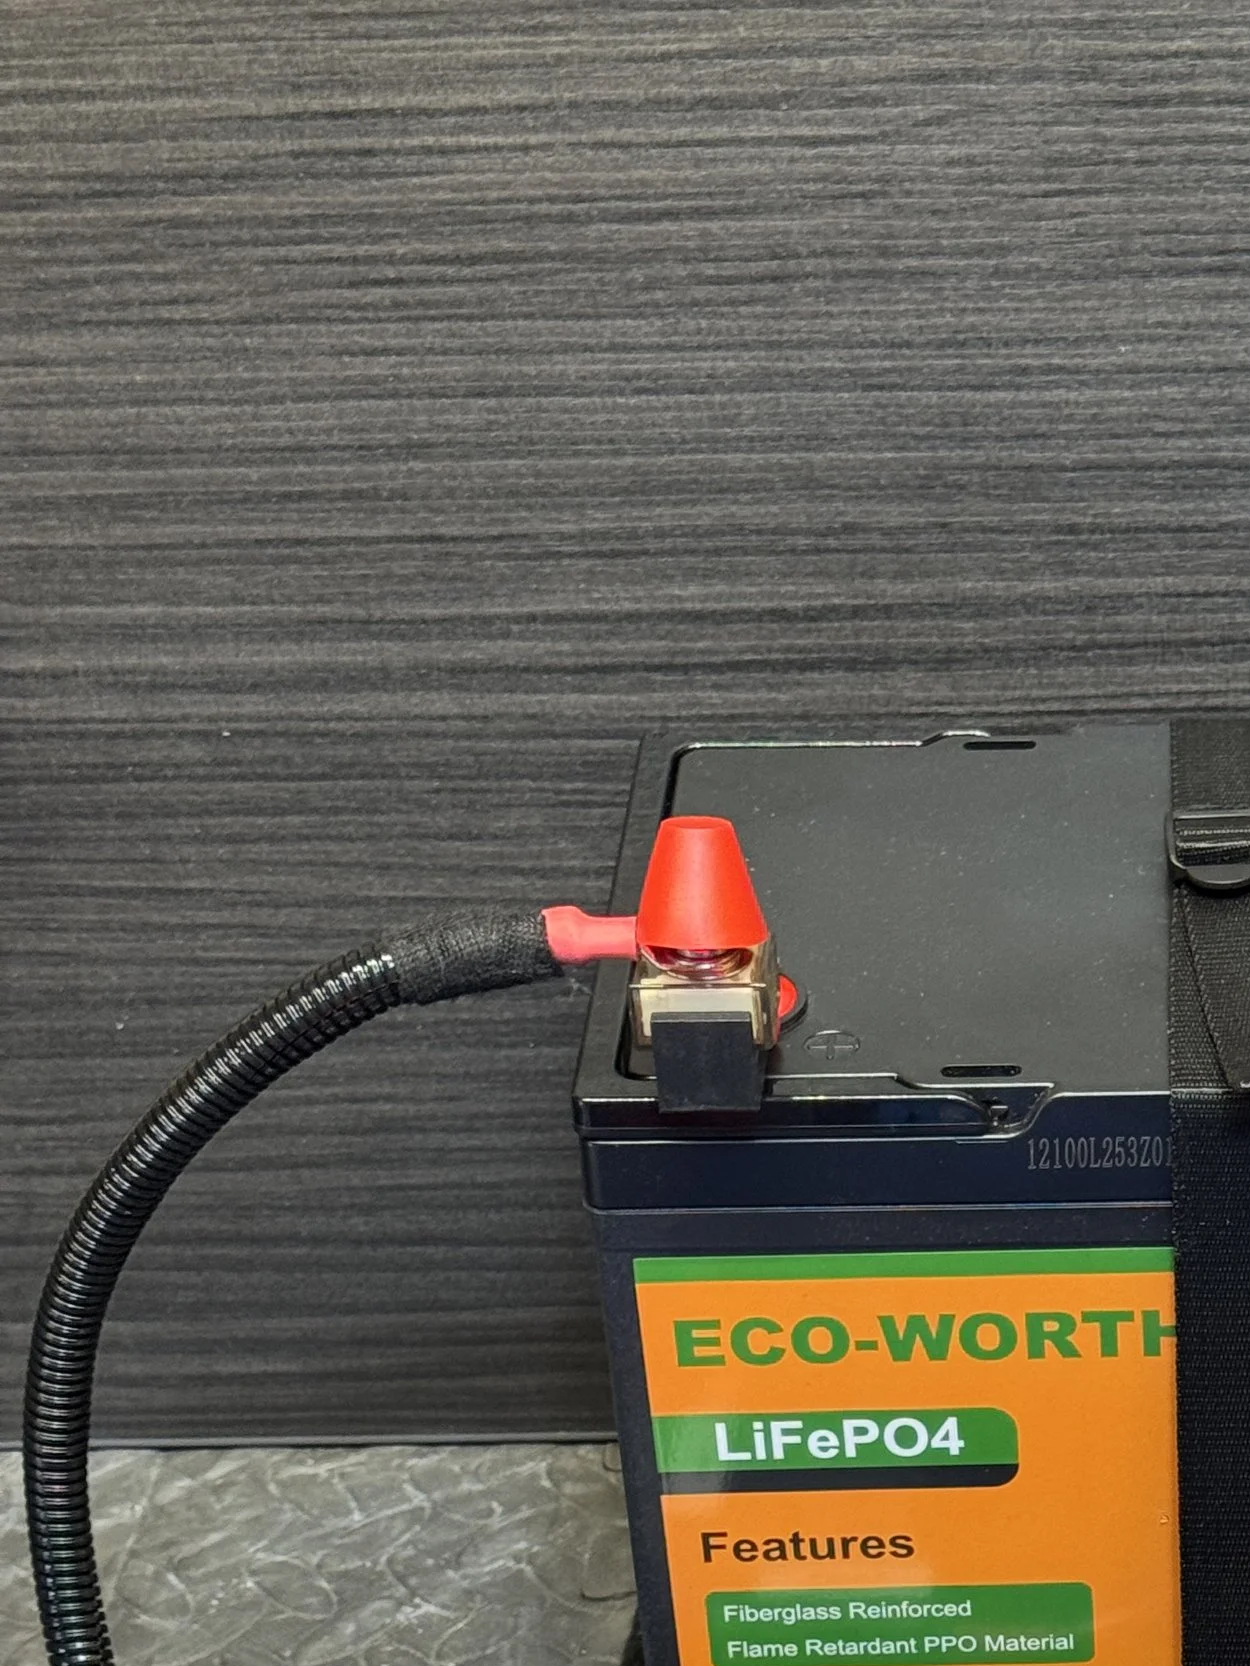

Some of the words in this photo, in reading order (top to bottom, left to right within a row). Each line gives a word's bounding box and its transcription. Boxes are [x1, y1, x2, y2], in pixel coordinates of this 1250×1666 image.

[672, 1309, 1177, 1367] ECO-WORTH
[714, 1416, 965, 1462] LiFePO4
[700, 1530, 915, 1563] Features
[723, 1603, 842, 1626] Fiberglass
[849, 1600, 972, 1620] Reinforced
[727, 1639, 798, 1659] Flame
[805, 1636, 918, 1656] Retardant
[924, 1635, 977, 1654] PPO
[984, 1633, 1074, 1652] Material
